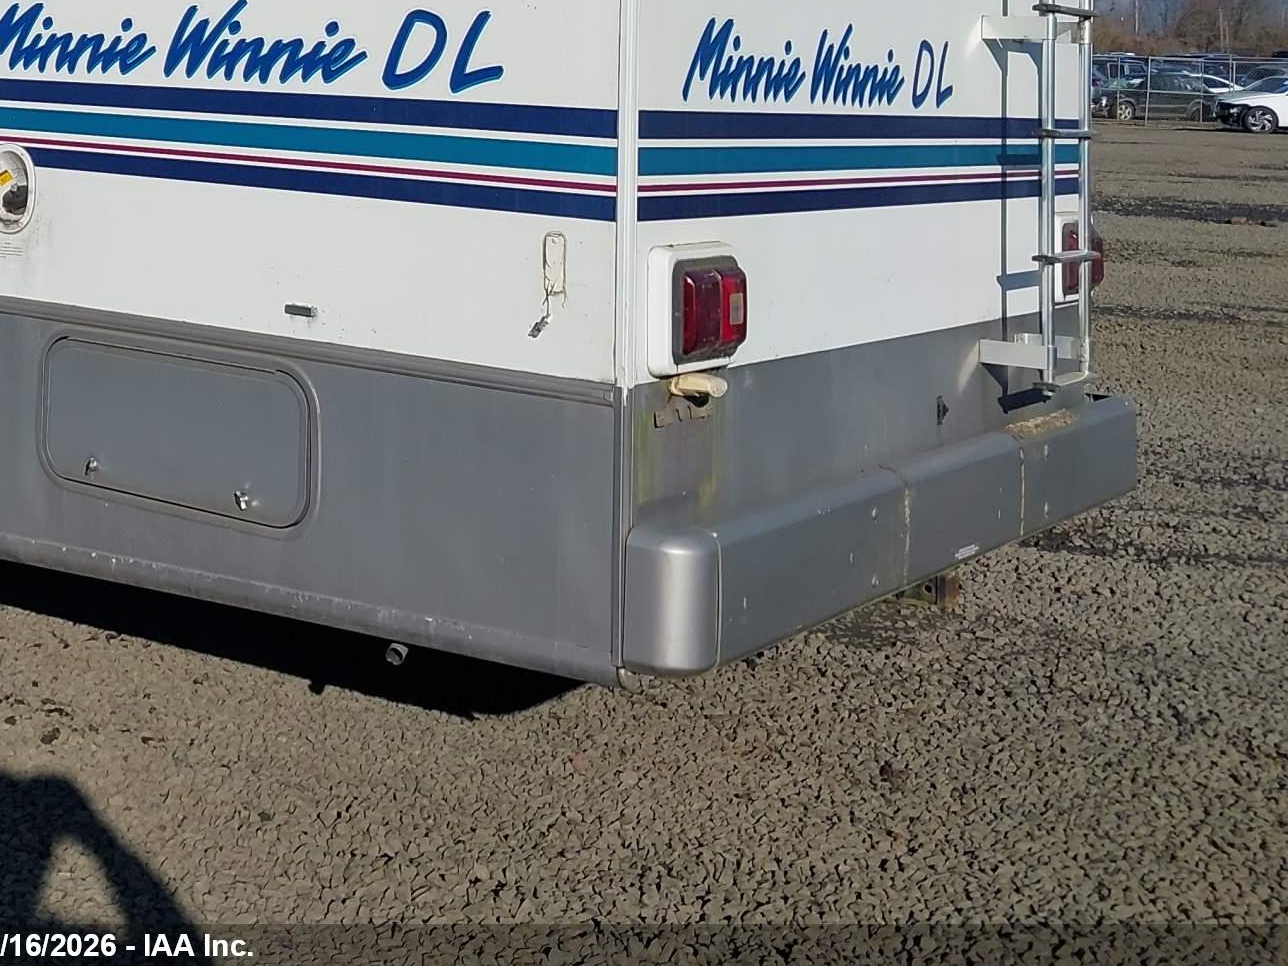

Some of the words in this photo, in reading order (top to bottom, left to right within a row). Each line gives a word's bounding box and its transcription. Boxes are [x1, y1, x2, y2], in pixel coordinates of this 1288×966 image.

[381, 9, 505, 94] DL
[682, 17, 806, 103] Minnie
[810, 23, 905, 108] Winnie
[912, 39, 954, 109] DL
